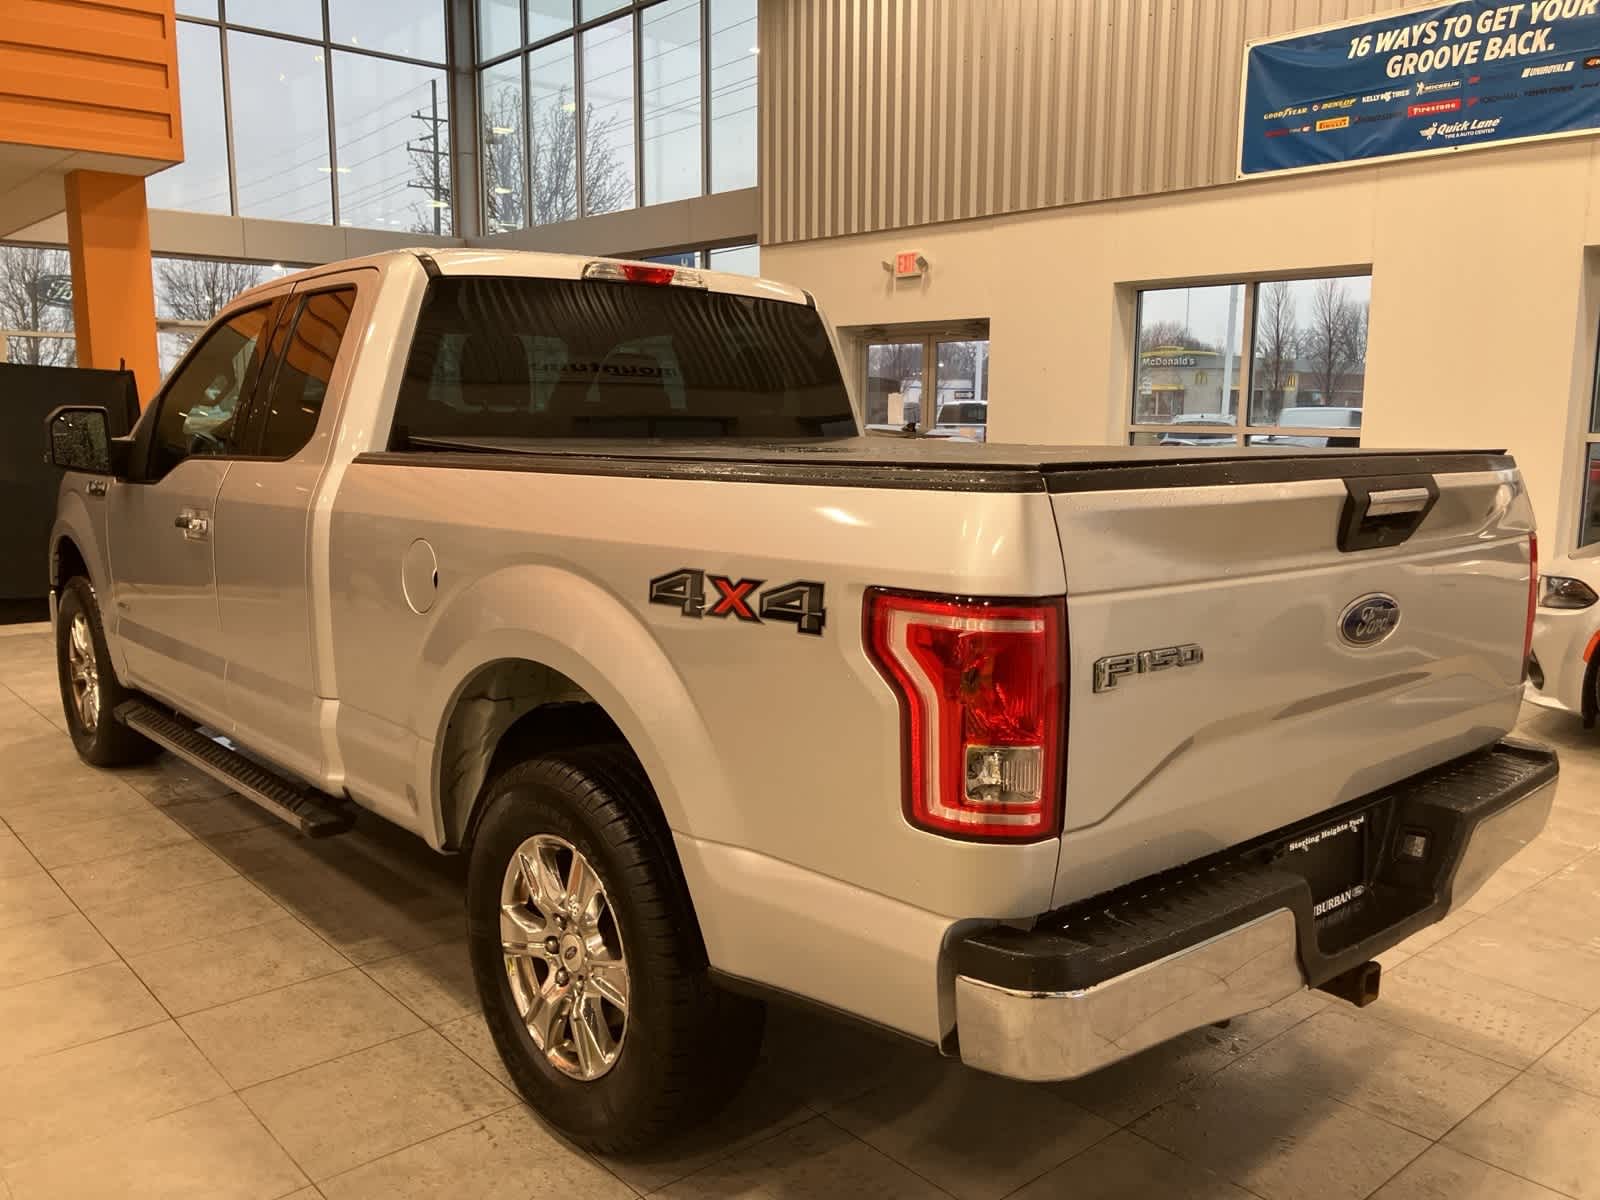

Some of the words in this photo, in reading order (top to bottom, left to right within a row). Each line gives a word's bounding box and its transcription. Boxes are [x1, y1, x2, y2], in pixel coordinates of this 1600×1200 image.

[1348, 35, 1372, 59] 16
[1374, 20, 1439, 53] WAYS
[1443, 14, 1472, 40] TO
[1476, 4, 1524, 34] GET
[1529, 0, 1597, 25] YOUR
[1386, 40, 1481, 79] GROOVE
[1484, 28, 1555, 61] BACK.
[1425, 80, 1460, 91] MICHELIN
[1321, 98, 1357, 109] DUNLOP
[1362, 94, 1381, 103] KELLY
[1264, 107, 1308, 120] GOODYEAR
[1413, 103, 1456, 115] Firestone
[1437, 121, 1470, 135] Quick
[1470, 118, 1500, 130] Lane
[1142, 356, 1196, 367] McDonald's
[1355, 604, 1397, 637] Ford
[1289, 834, 1320, 851] Sterling
[1321, 823, 1348, 839] Heights
[1349, 815, 1364, 828] Ford
